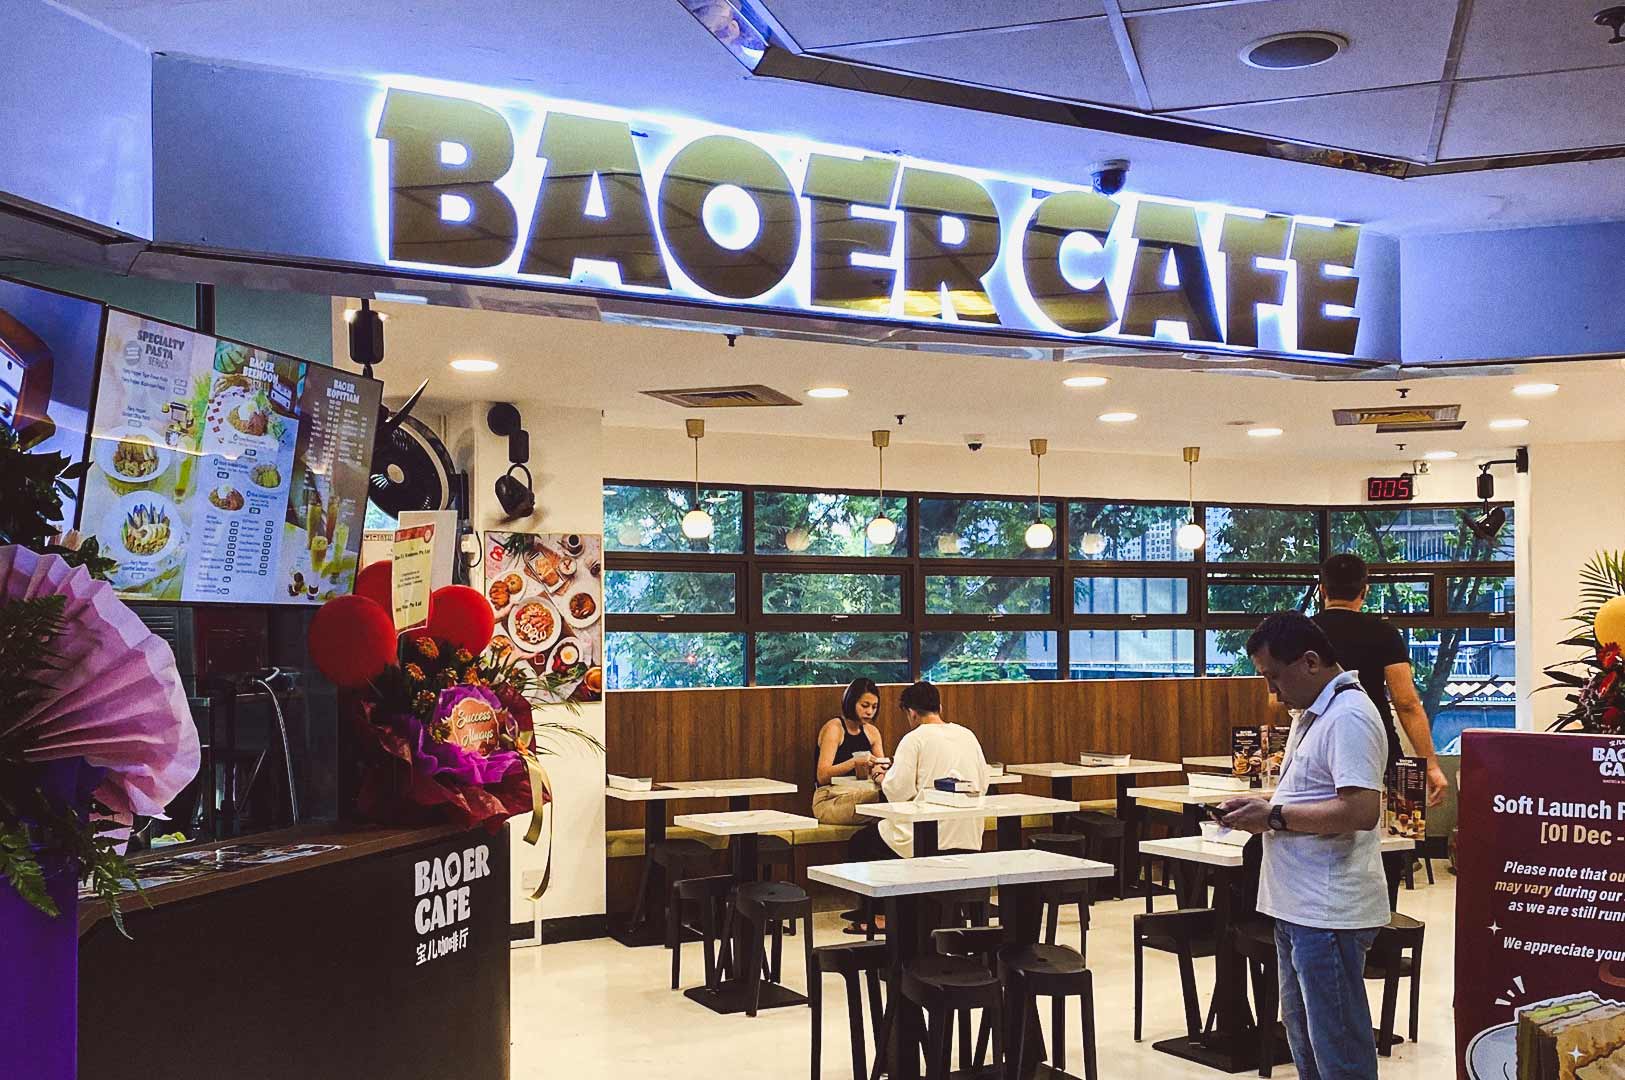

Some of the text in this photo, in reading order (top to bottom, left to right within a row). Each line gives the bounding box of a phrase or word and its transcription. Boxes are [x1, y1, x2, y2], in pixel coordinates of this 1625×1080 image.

[376, 87, 1361, 356] BAOER CAFE
[137, 330, 185, 351] SPECIALTY
[145, 344, 173, 360] PASTA
[1370, 480, 1409, 497] 005
[456, 710, 492, 728] Success
[1492, 794, 1534, 815] Soft
[1537, 797, 1612, 820] Launch
[1540, 822, 1568, 844] [01
[1573, 824, 1612, 846] Dec
[414, 845, 490, 896] BAOER
[1503, 861, 1546, 876] Please
[1548, 866, 1578, 879] note
[1579, 867, 1607, 881] that
[1494, 881, 1623, 902] may vary during our
[414, 886, 471, 935] CAFE
[1508, 901, 1524, 912] as
[1526, 903, 1545, 914] we
[1547, 904, 1569, 916] are
[1571, 905, 1597, 919] still
[1503, 936, 1522, 949] We
[1523, 941, 1595, 958] appreciate
